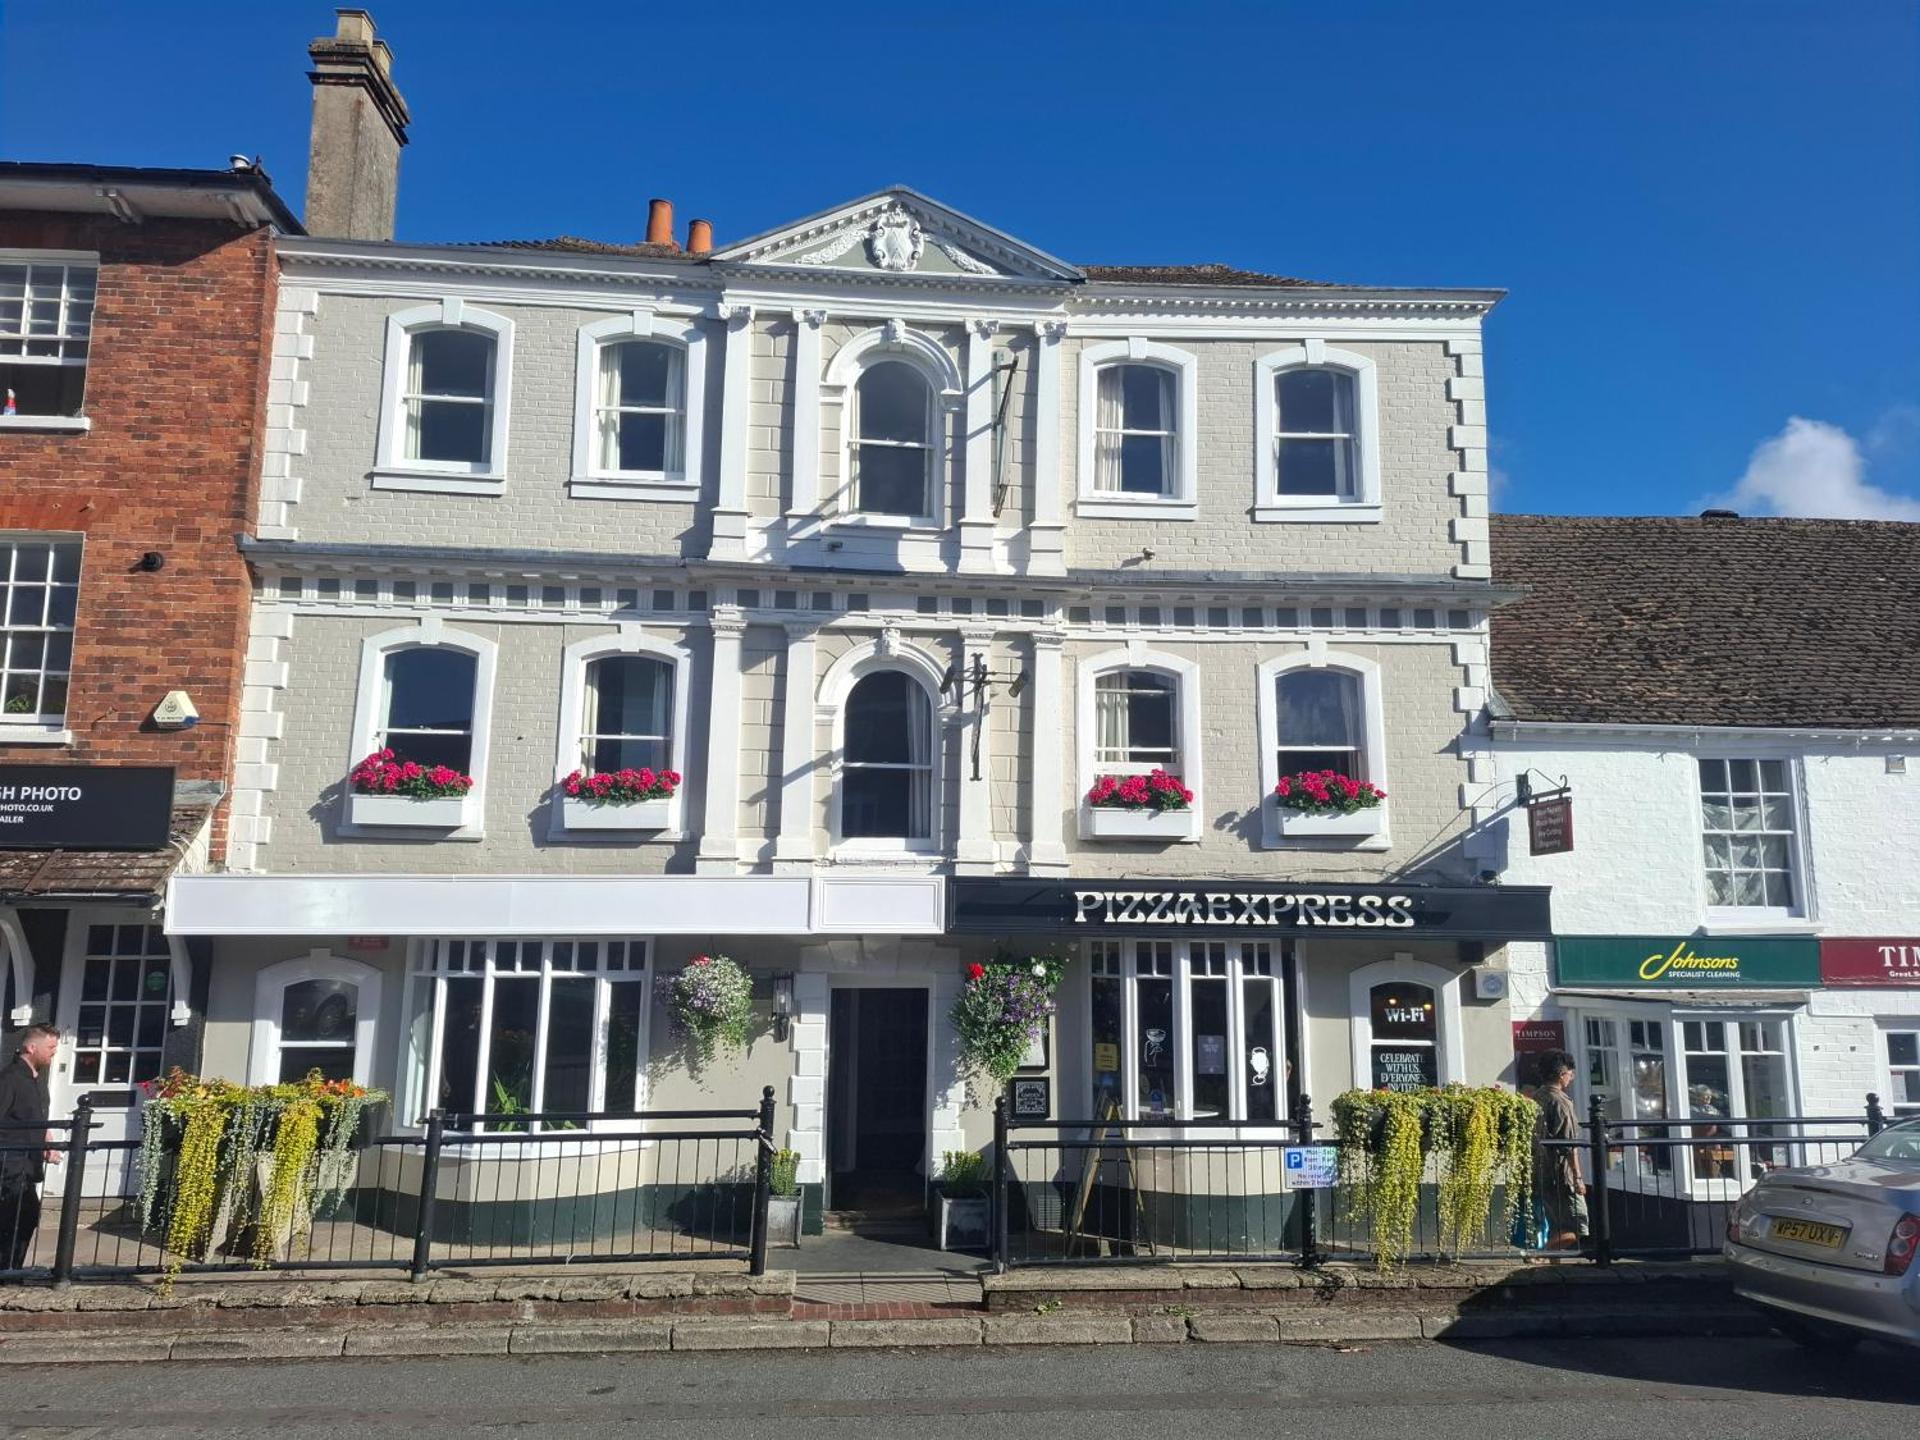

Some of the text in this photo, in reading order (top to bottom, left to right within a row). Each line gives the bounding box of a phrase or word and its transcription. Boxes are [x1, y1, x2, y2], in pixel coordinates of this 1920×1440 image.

[20, 786, 81, 800] PHOTO
[0, 804, 54, 812] HOTO.CO.UK
[1074, 891, 1414, 927] PIZZAEXPRESS
[1638, 941, 1739, 980] Johnsons
[1384, 1007, 1425, 1022] Wi-Fi
[1515, 1030, 1557, 1038] TIMPSON
[1386, 1063, 1408, 1073] WITH
